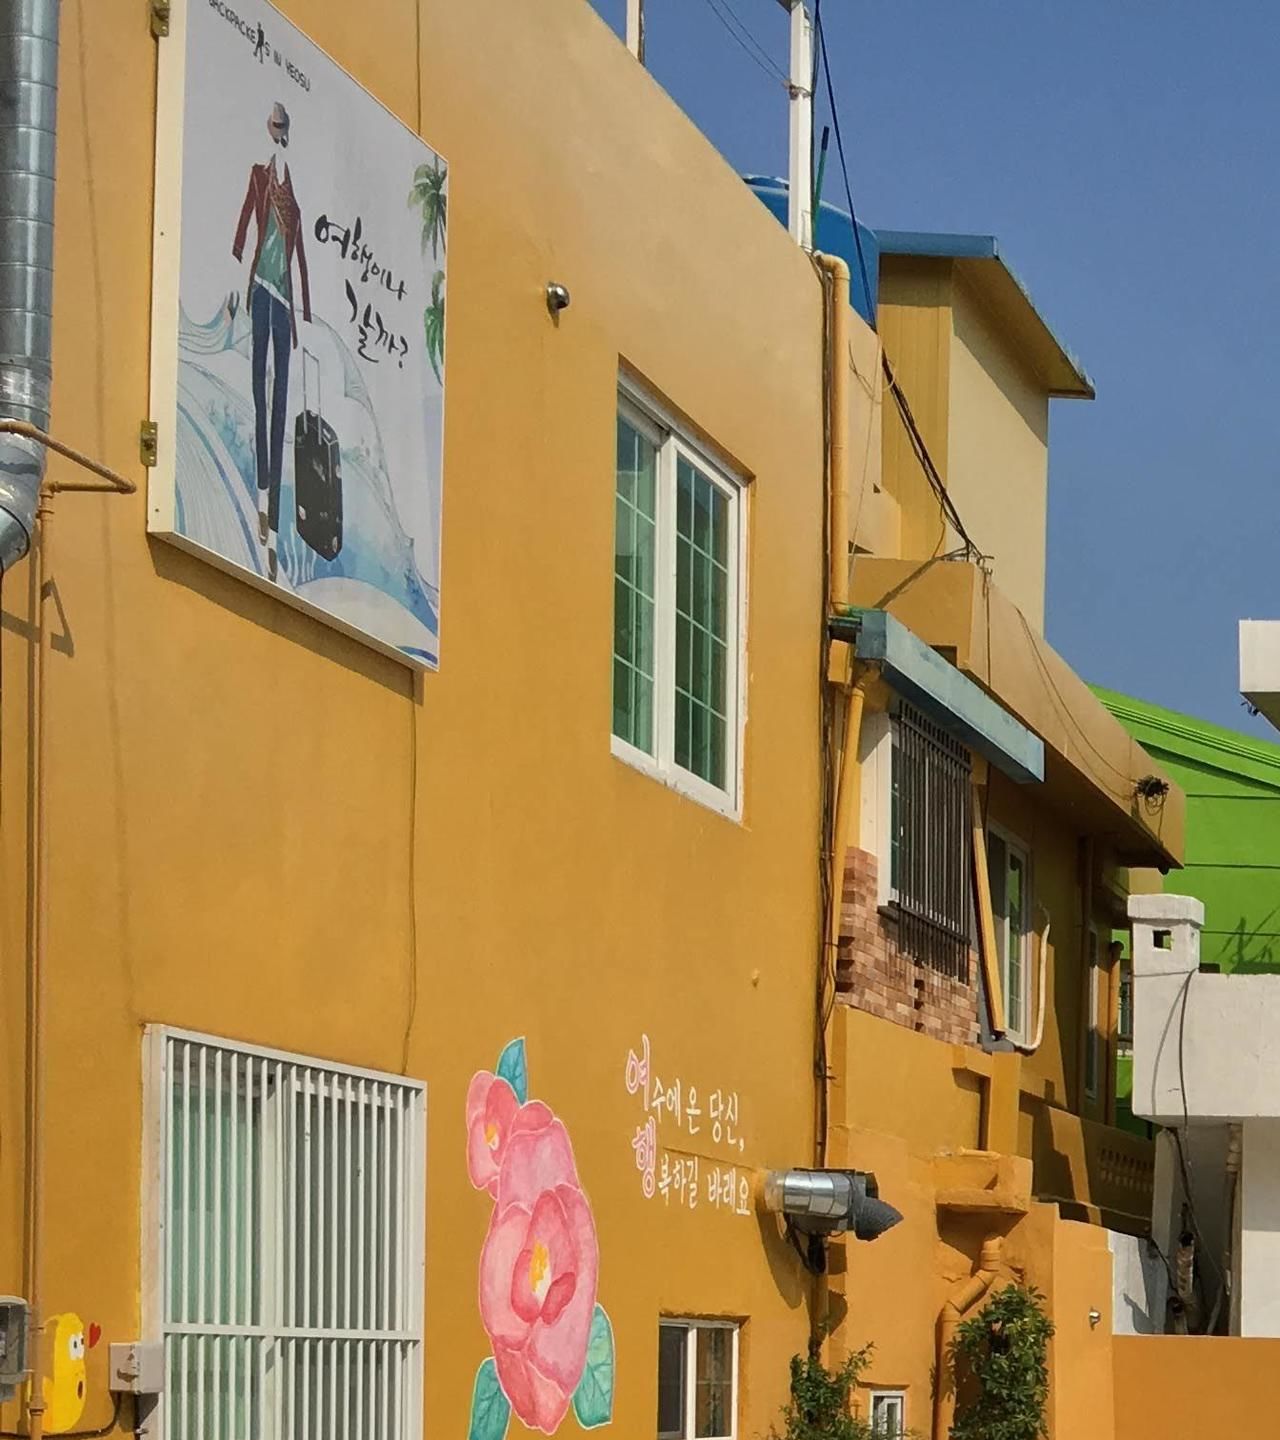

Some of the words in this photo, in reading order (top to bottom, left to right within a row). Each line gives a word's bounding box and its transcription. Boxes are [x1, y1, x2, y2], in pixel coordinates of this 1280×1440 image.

[285, 58, 311, 92] YEOSU
[345, 278, 409, 369] 갈까?
[709, 1088, 746, 1152] 당신,
[631, 1114, 700, 1210] 행복하길
[707, 1166, 752, 1216] 바래요
